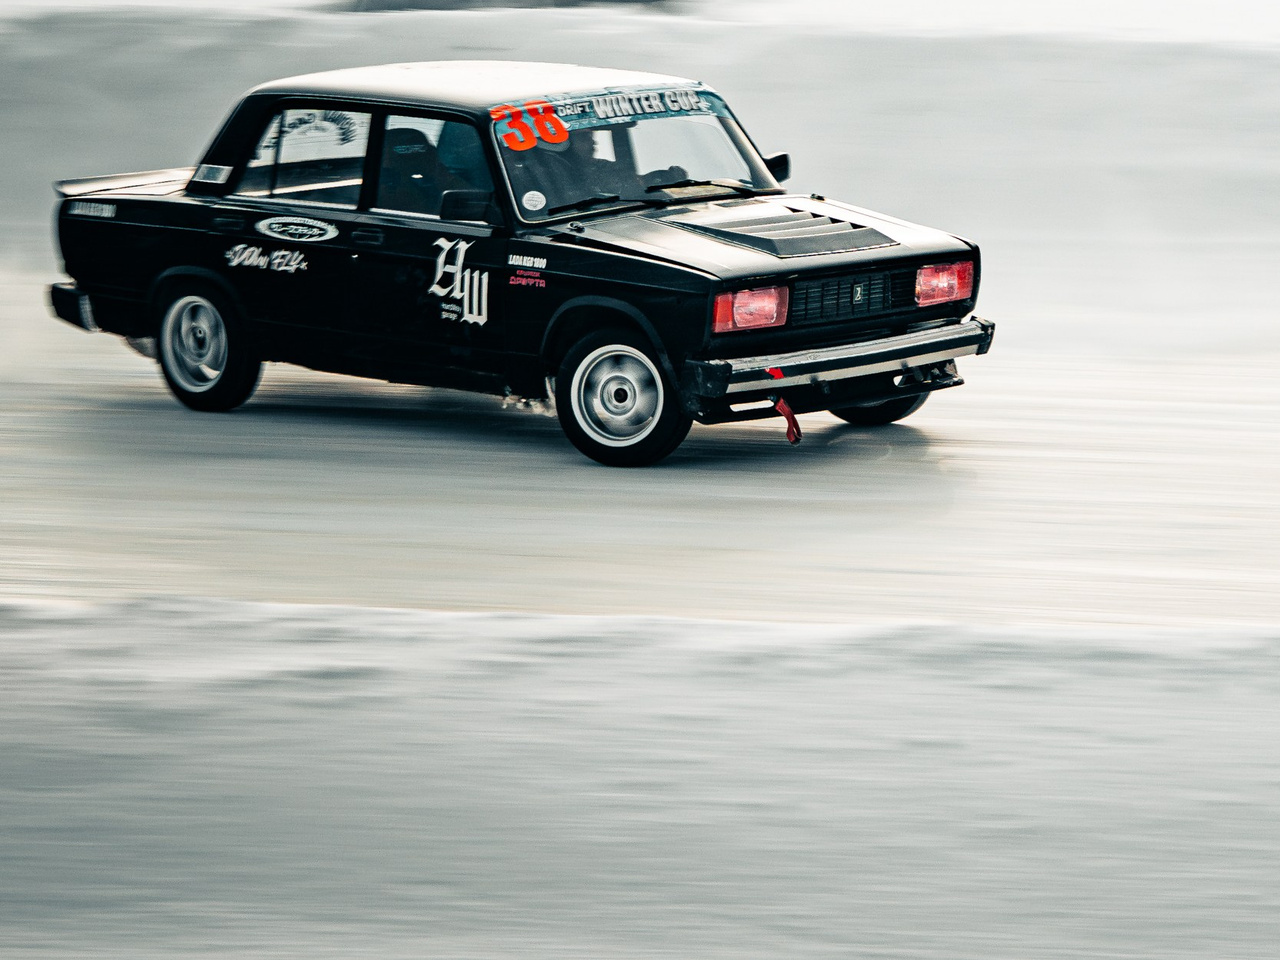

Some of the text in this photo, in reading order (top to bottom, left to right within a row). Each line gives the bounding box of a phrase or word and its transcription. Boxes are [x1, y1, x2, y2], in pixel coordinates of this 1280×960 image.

[556, 90, 701, 119] DRIFT WINTER CUP
[489, 99, 569, 151] 38
